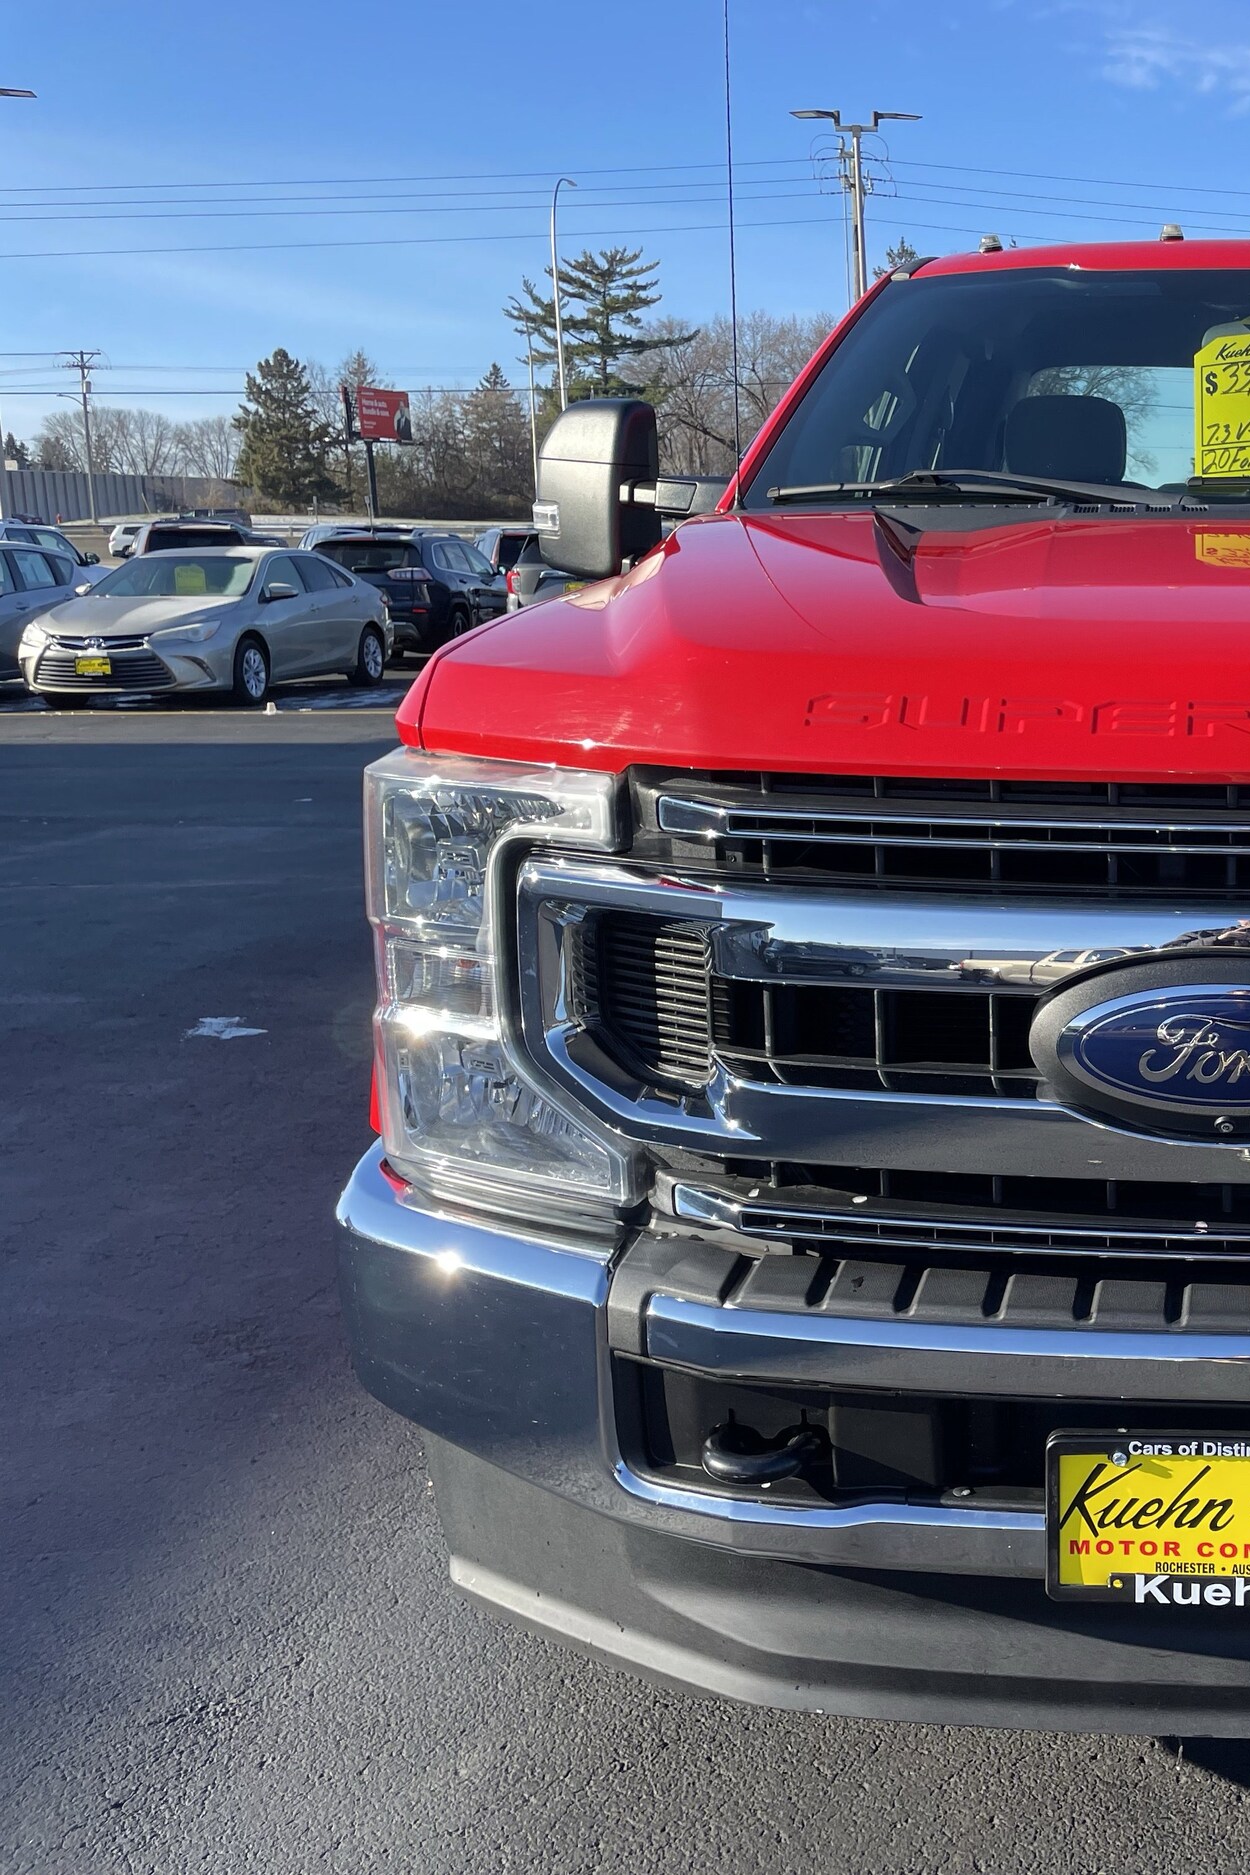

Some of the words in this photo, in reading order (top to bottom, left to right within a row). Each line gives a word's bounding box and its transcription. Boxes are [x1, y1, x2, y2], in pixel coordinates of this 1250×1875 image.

[1207, 423, 1231, 445] 7.3
[1128, 1441, 1175, 1457] Cars
[1178, 1441, 1198, 1457] of
[1060, 1463, 1235, 1538] Kuehn
[1069, 1540, 1182, 1557] MOTOR
[1155, 1562, 1215, 1574] ROCHESTER
